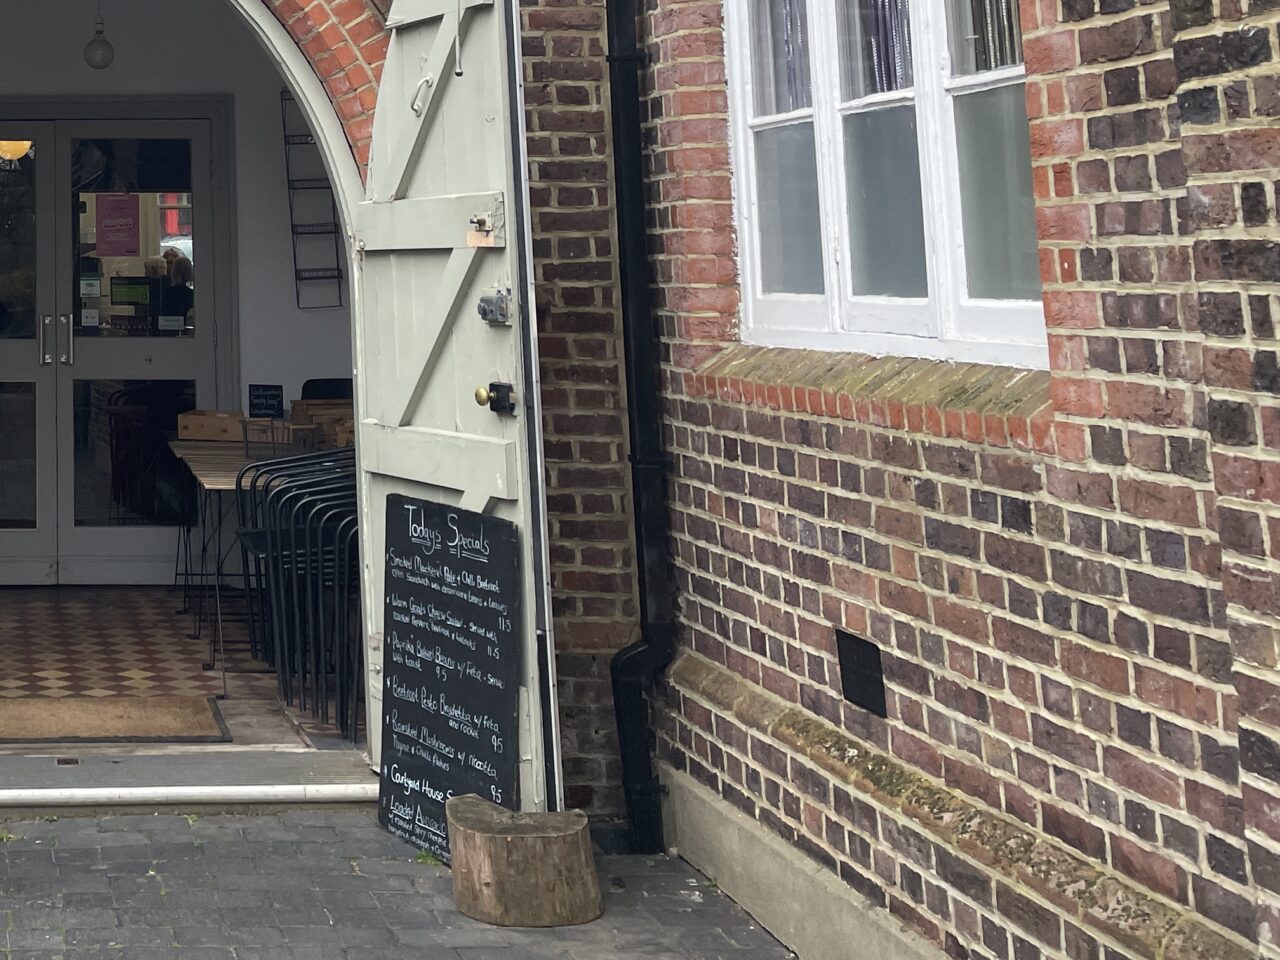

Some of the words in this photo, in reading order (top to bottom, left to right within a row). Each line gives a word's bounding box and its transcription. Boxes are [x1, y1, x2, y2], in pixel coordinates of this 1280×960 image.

[446, 513, 490, 559] Specials
[435, 646, 456, 666] Beans
[421, 686, 438, 710] Pesto
[390, 764, 420, 795] Courtyard
[422, 779, 445, 803] House
